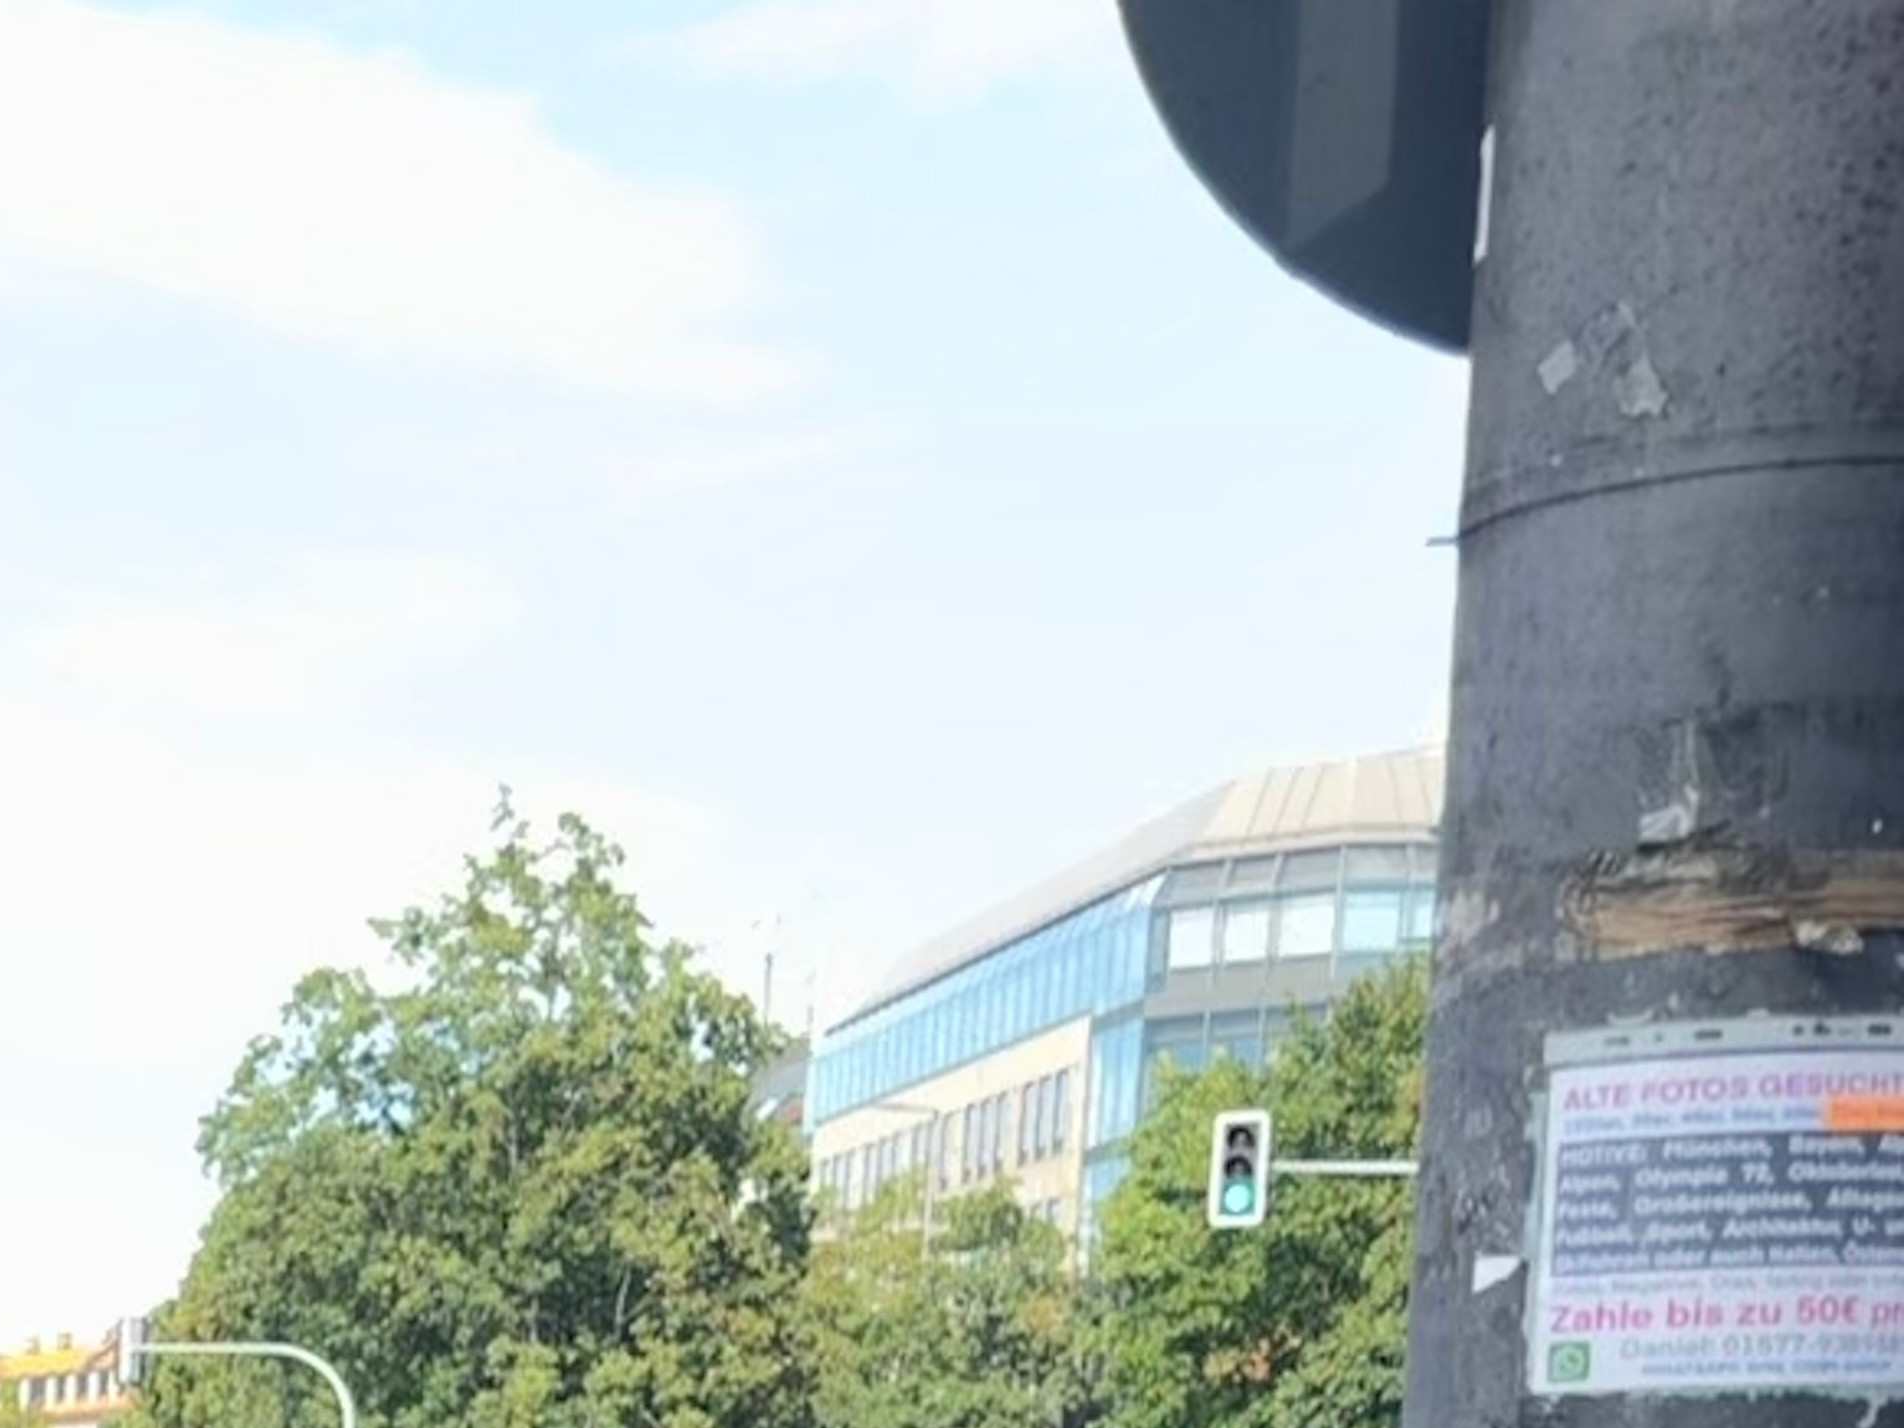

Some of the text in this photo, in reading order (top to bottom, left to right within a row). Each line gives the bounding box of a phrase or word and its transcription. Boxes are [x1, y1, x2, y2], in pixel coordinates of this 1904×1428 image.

[1563, 1083, 1630, 1110] ALTE
[1641, 1077, 1749, 1105] FOTOS
[1551, 1303, 1652, 1334] Zahle
[1666, 1297, 1723, 1329] bis
[1738, 1304, 1780, 1326] zu
[1872, 1304, 1904, 1332] pr
